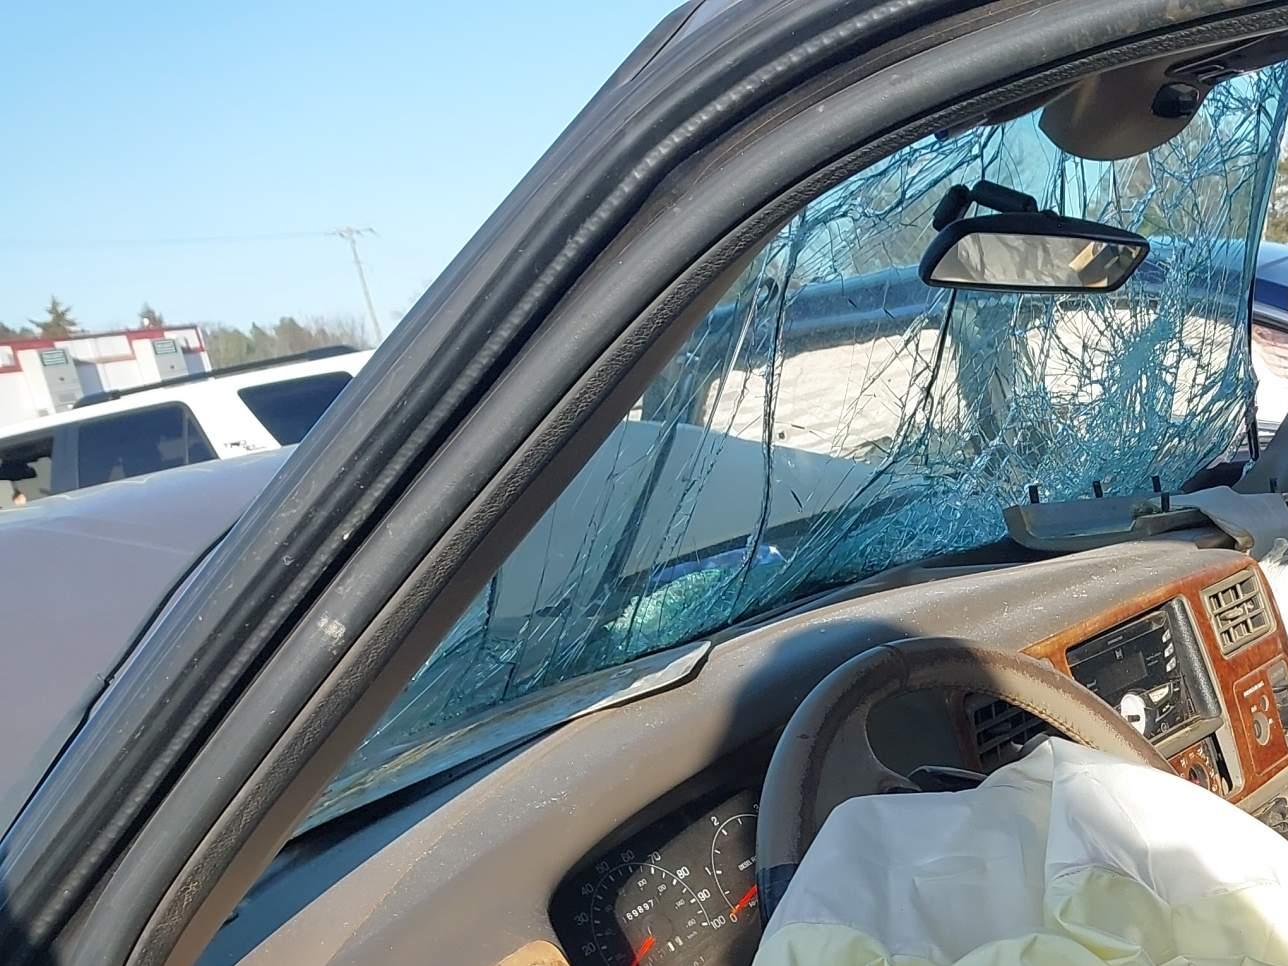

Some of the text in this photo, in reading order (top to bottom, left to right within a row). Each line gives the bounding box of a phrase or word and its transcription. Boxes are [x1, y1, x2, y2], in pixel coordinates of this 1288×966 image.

[710, 816, 720, 826] 2
[621, 849, 635, 862] 60
[647, 851, 661, 864] 70
[595, 861, 610, 873] 50
[676, 866, 690, 879] 80
[704, 866, 712, 876] 1
[581, 883, 594, 896] 40
[697, 889, 711, 902] 90
[575, 913, 589, 926] 30
[710, 915, 726, 930] 100
[729, 912, 738, 923] 0
[582, 942, 597, 957] 20
